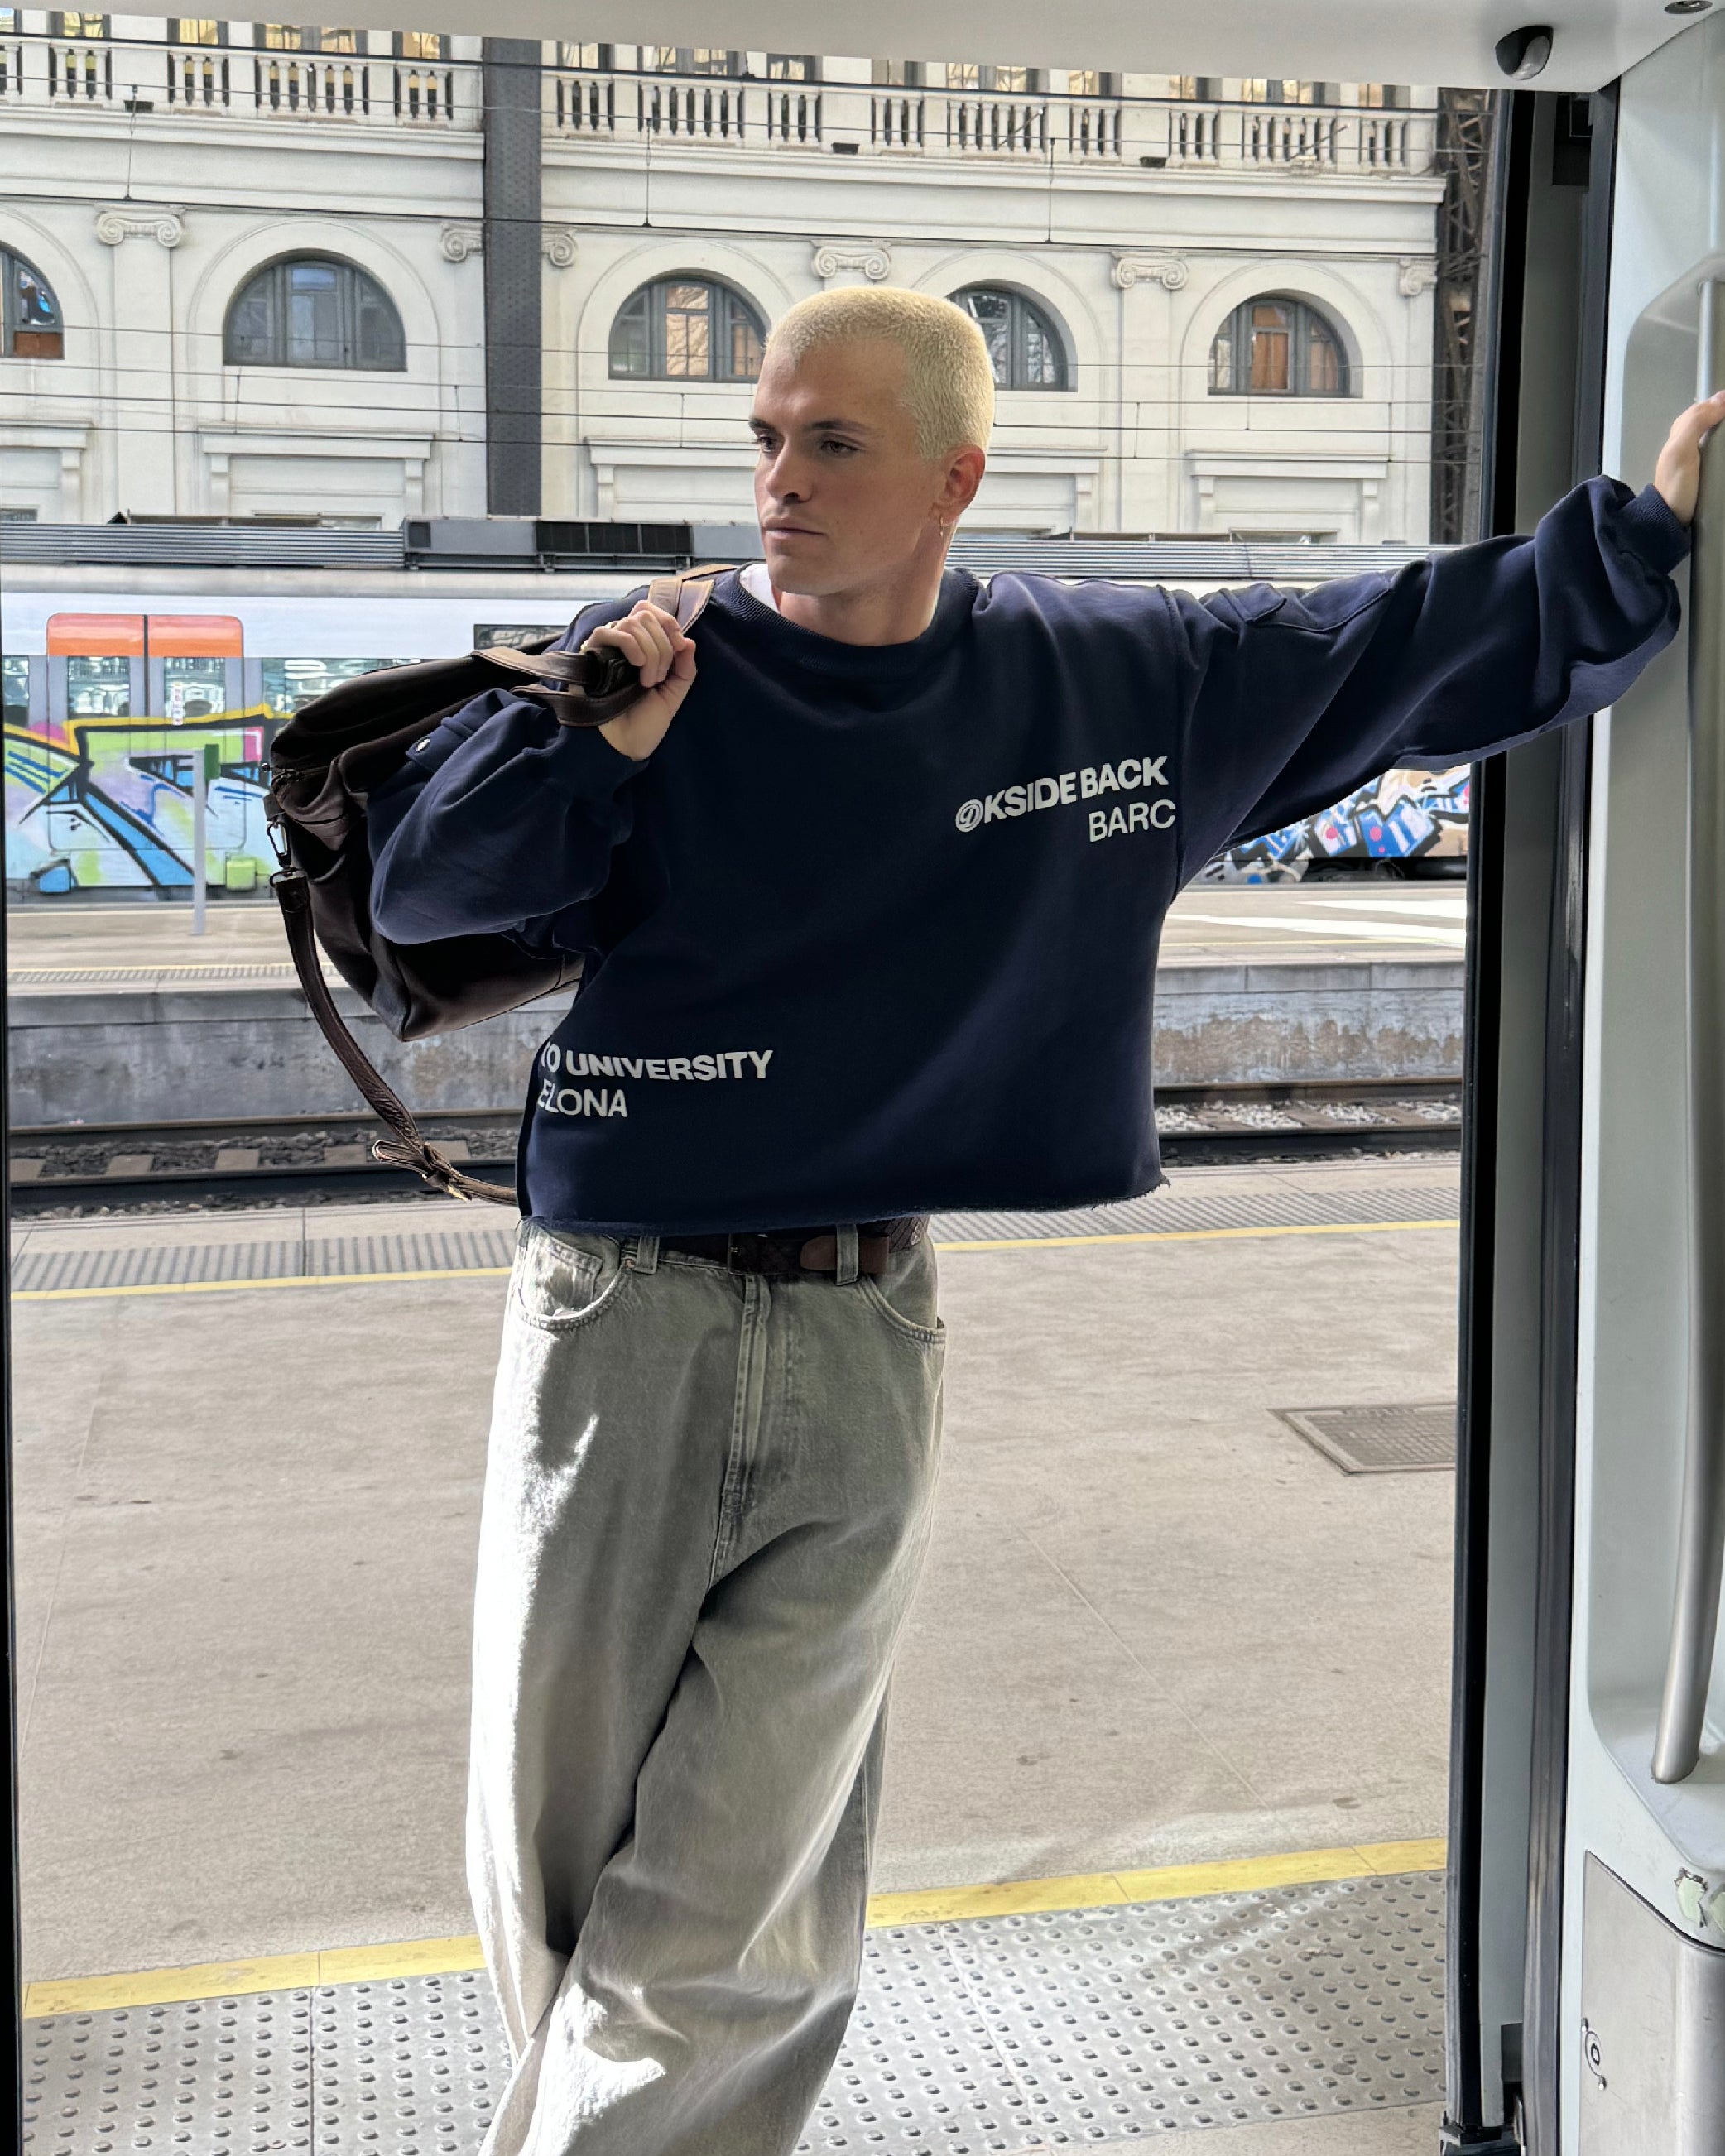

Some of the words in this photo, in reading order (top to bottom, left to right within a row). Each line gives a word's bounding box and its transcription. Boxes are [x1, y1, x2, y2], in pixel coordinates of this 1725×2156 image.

[1080, 756, 1169, 799] BACK
[1088, 799, 1175, 843] BARC
[566, 1049, 773, 1079] UNIVERSITY
[537, 1078, 627, 1117] ELONA
